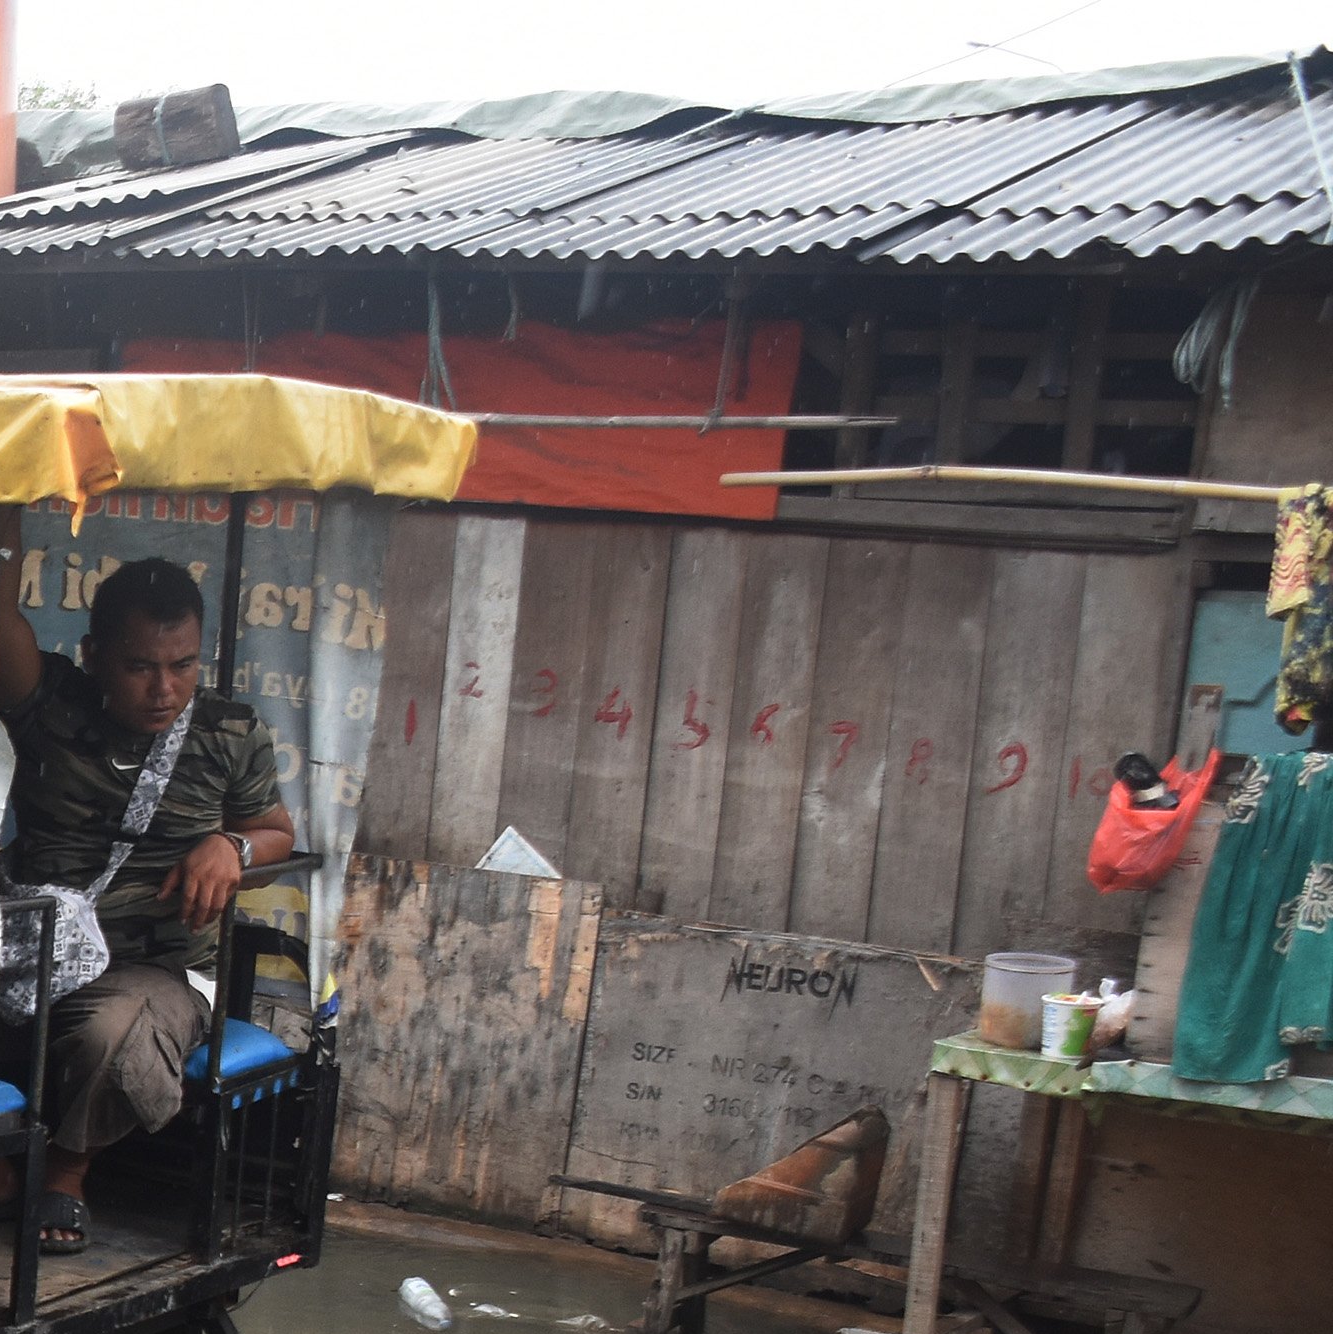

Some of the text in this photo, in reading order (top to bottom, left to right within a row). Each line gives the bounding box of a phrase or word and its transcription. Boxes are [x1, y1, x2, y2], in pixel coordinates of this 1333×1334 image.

[459, 661, 484, 699] 2
[531, 668, 558, 719] 3
[594, 685, 632, 741] 4
[672, 685, 715, 751] 5
[751, 702, 781, 746] 6
[828, 720, 858, 774] 7
[905, 737, 933, 785] 8
[984, 741, 1029, 795] 9
[719, 946, 860, 1021] NEURON
